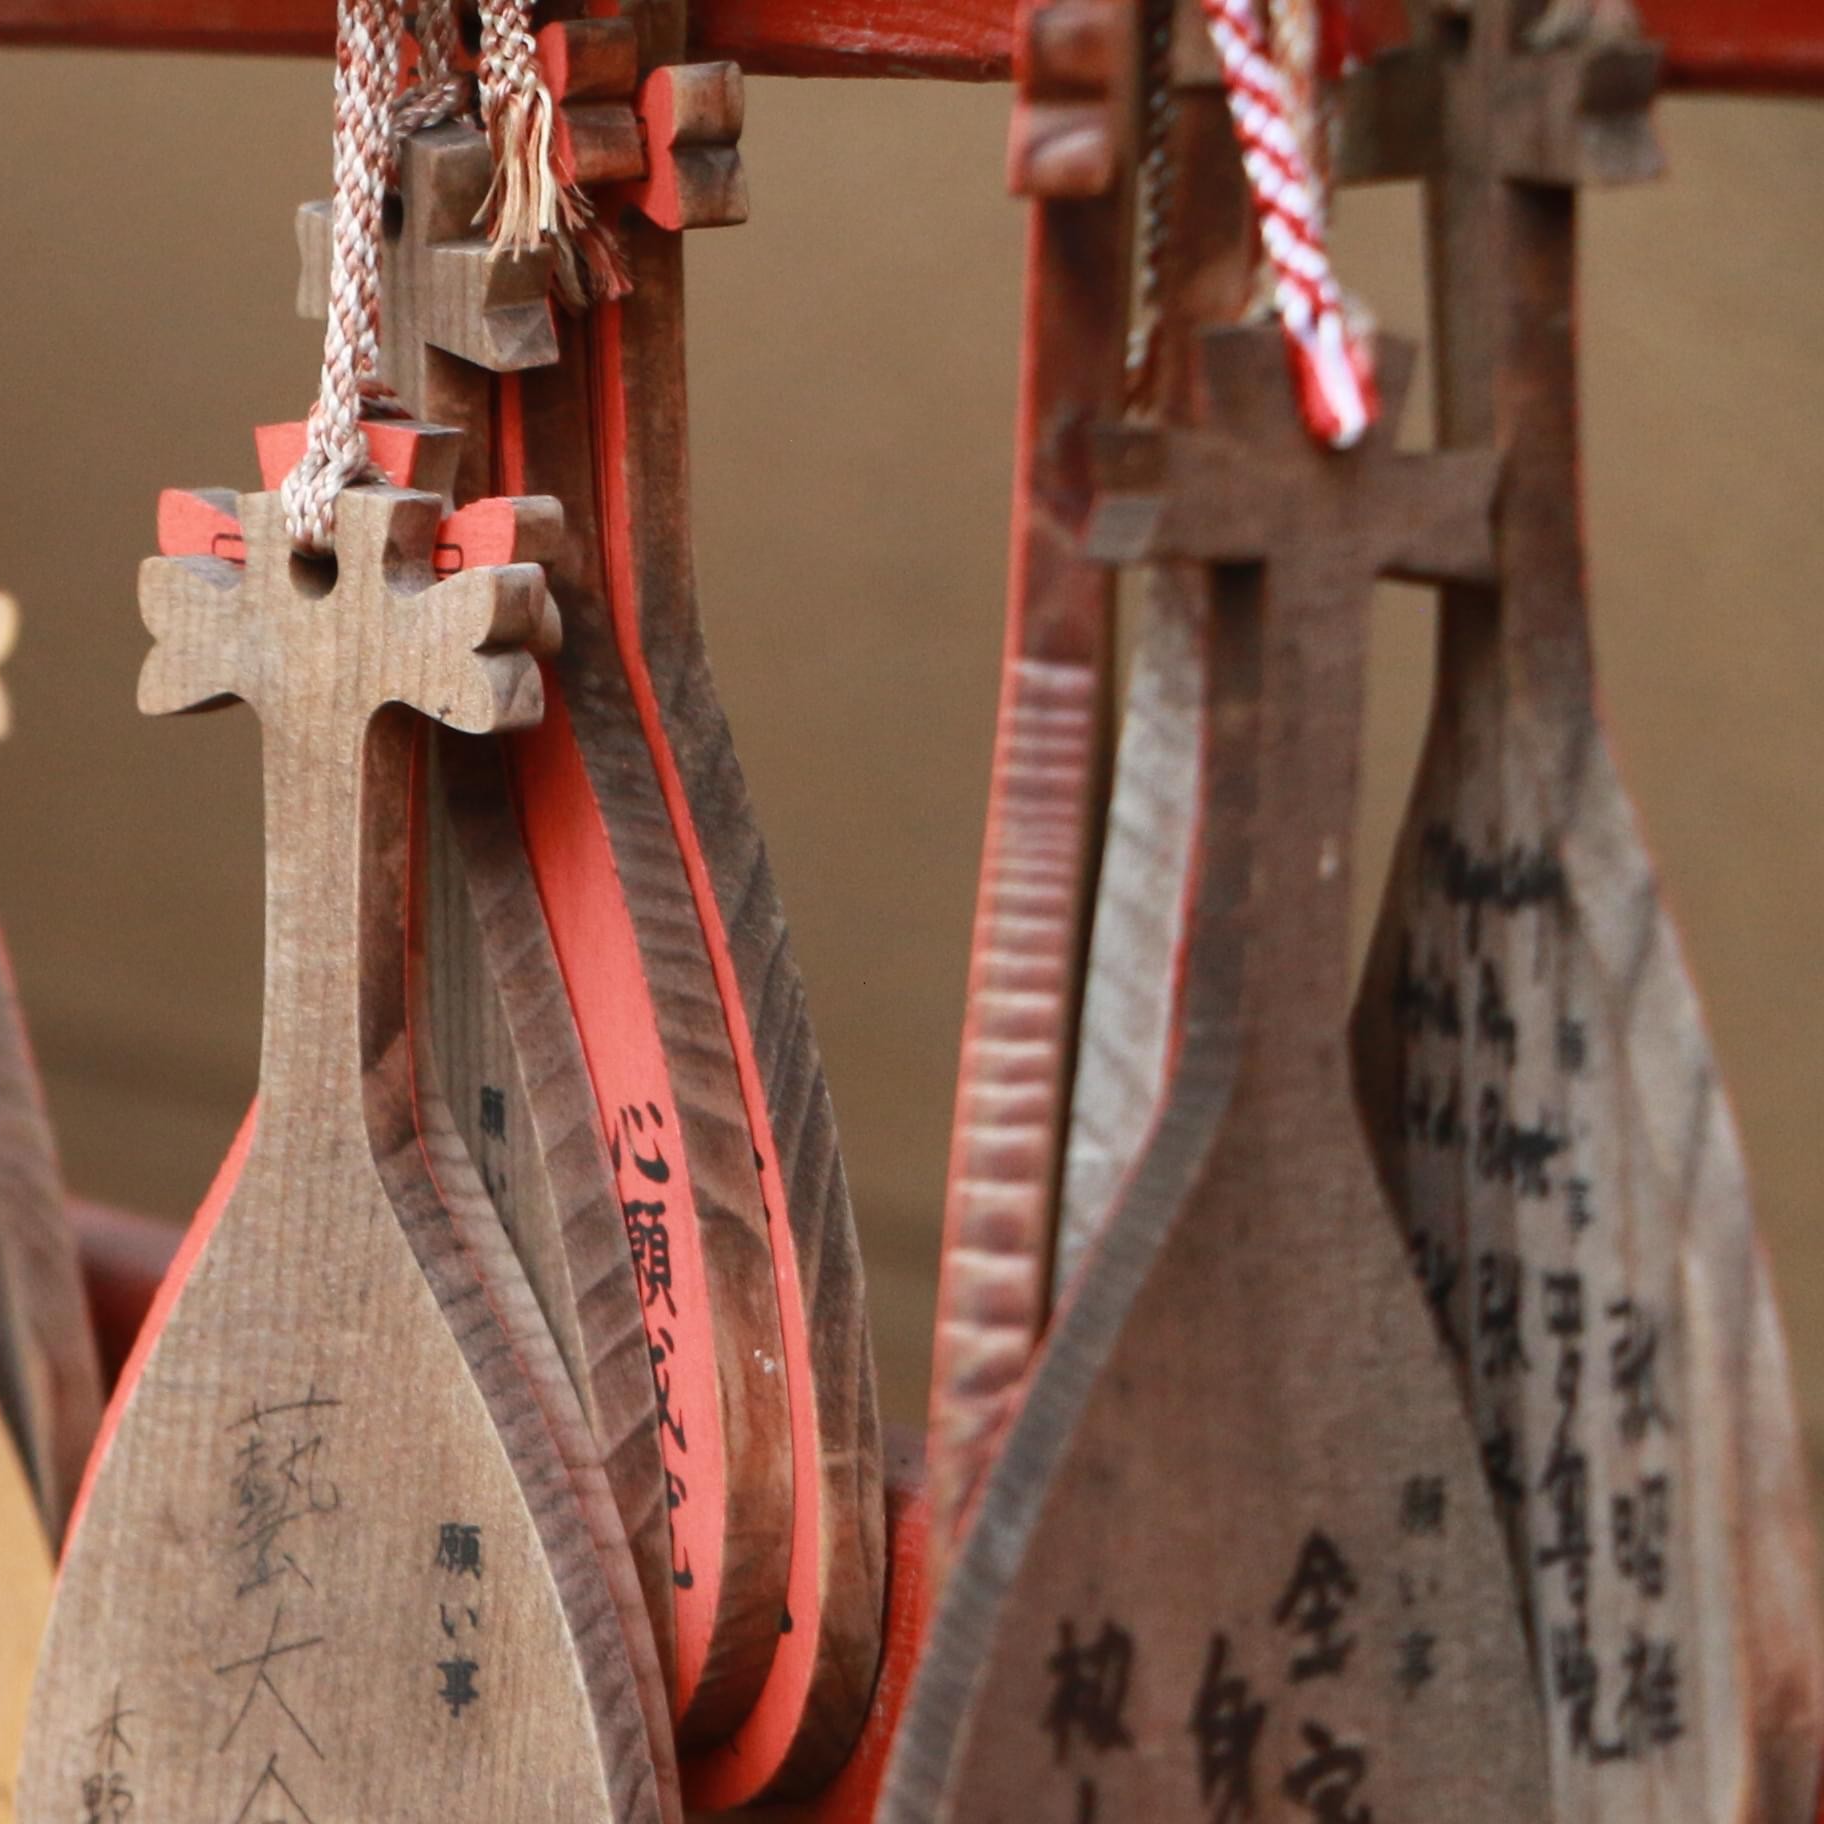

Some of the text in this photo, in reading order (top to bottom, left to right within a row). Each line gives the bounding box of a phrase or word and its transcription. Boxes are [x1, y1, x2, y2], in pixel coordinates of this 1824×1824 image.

[435, 1521, 484, 1719] 願い事
[1394, 1473, 1446, 1702] 願い事
